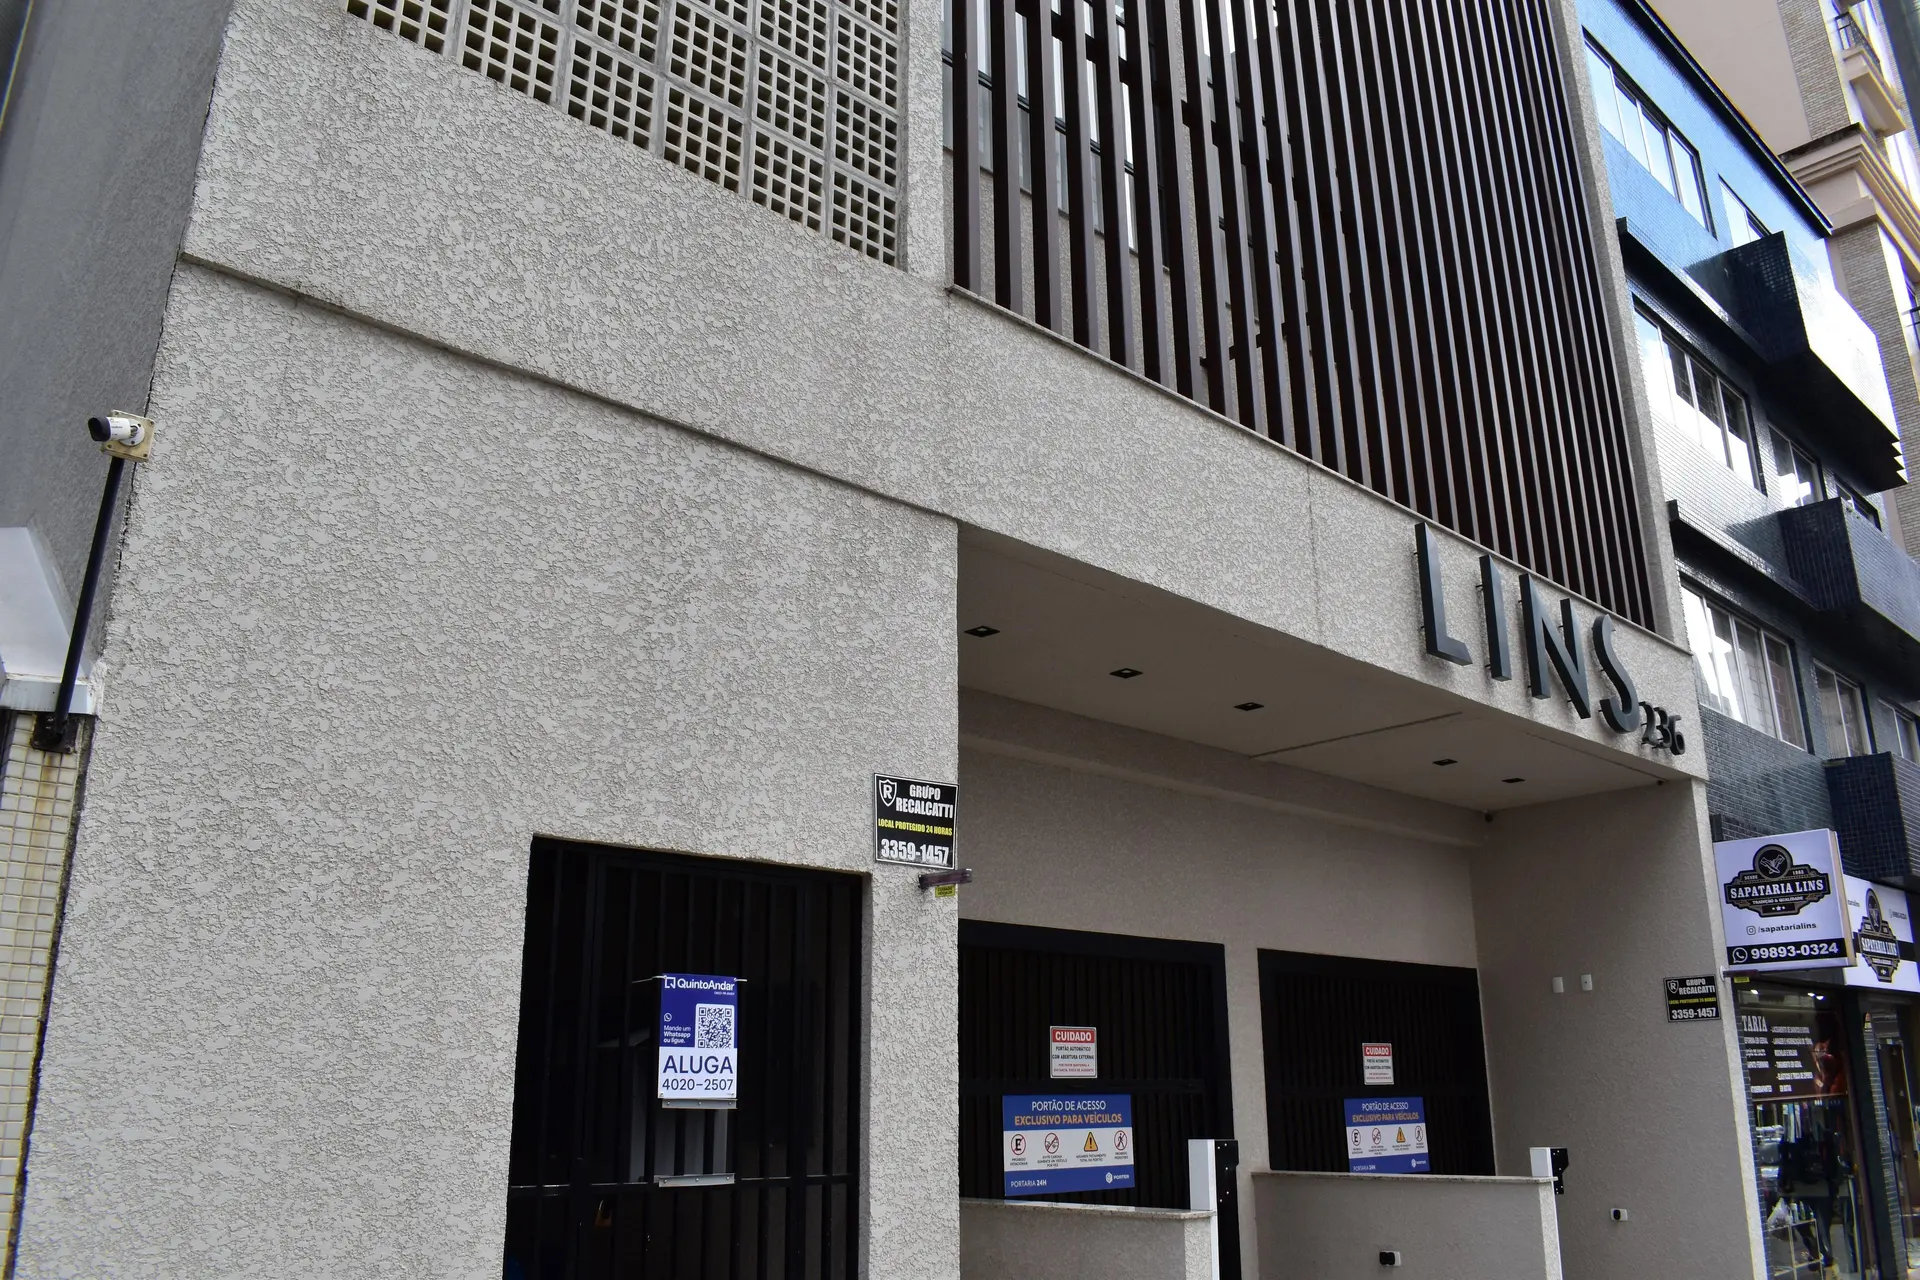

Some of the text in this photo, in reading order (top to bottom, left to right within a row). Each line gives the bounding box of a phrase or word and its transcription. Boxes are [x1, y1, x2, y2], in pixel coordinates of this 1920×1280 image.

[1415, 522, 1686, 756] LINS 236
[910, 784, 941, 800] GRUPO
[896, 797, 954, 818] RECALCATTI
[878, 818, 953, 836] LOCAL PROTEGIDO 24 HORAS
[881, 838, 949, 865] 3359-1457
[1730, 879, 1824, 899] SAPATARIA LINS
[1751, 942, 1838, 960] 99893-0324
[677, 978, 735, 990] QuintoAndar
[1679, 985, 1715, 995] RECALCATTI
[1672, 1007, 1716, 1019] 3359-1457
[1742, 1016, 1768, 1032] TARIA
[1056, 1031, 1091, 1041] CUIDADO
[1366, 1046, 1389, 1054] CUIDADO
[663, 1056, 733, 1074] ALUGA
[662, 1078, 733, 1091] 4020-2507
[1032, 1099, 1106, 1111] PORTÃO DE ACESSO
[1362, 1101, 1382, 1111] PORTÃO
[1390, 1102, 1408, 1110] ACESSO
[1015, 1112, 1122, 1126] EXCLUSIVO PARA VEÍCULOS
[1352, 1114, 1381, 1122] EXCLUSIVO
[1395, 1111, 1419, 1120] VEÍCULOS
